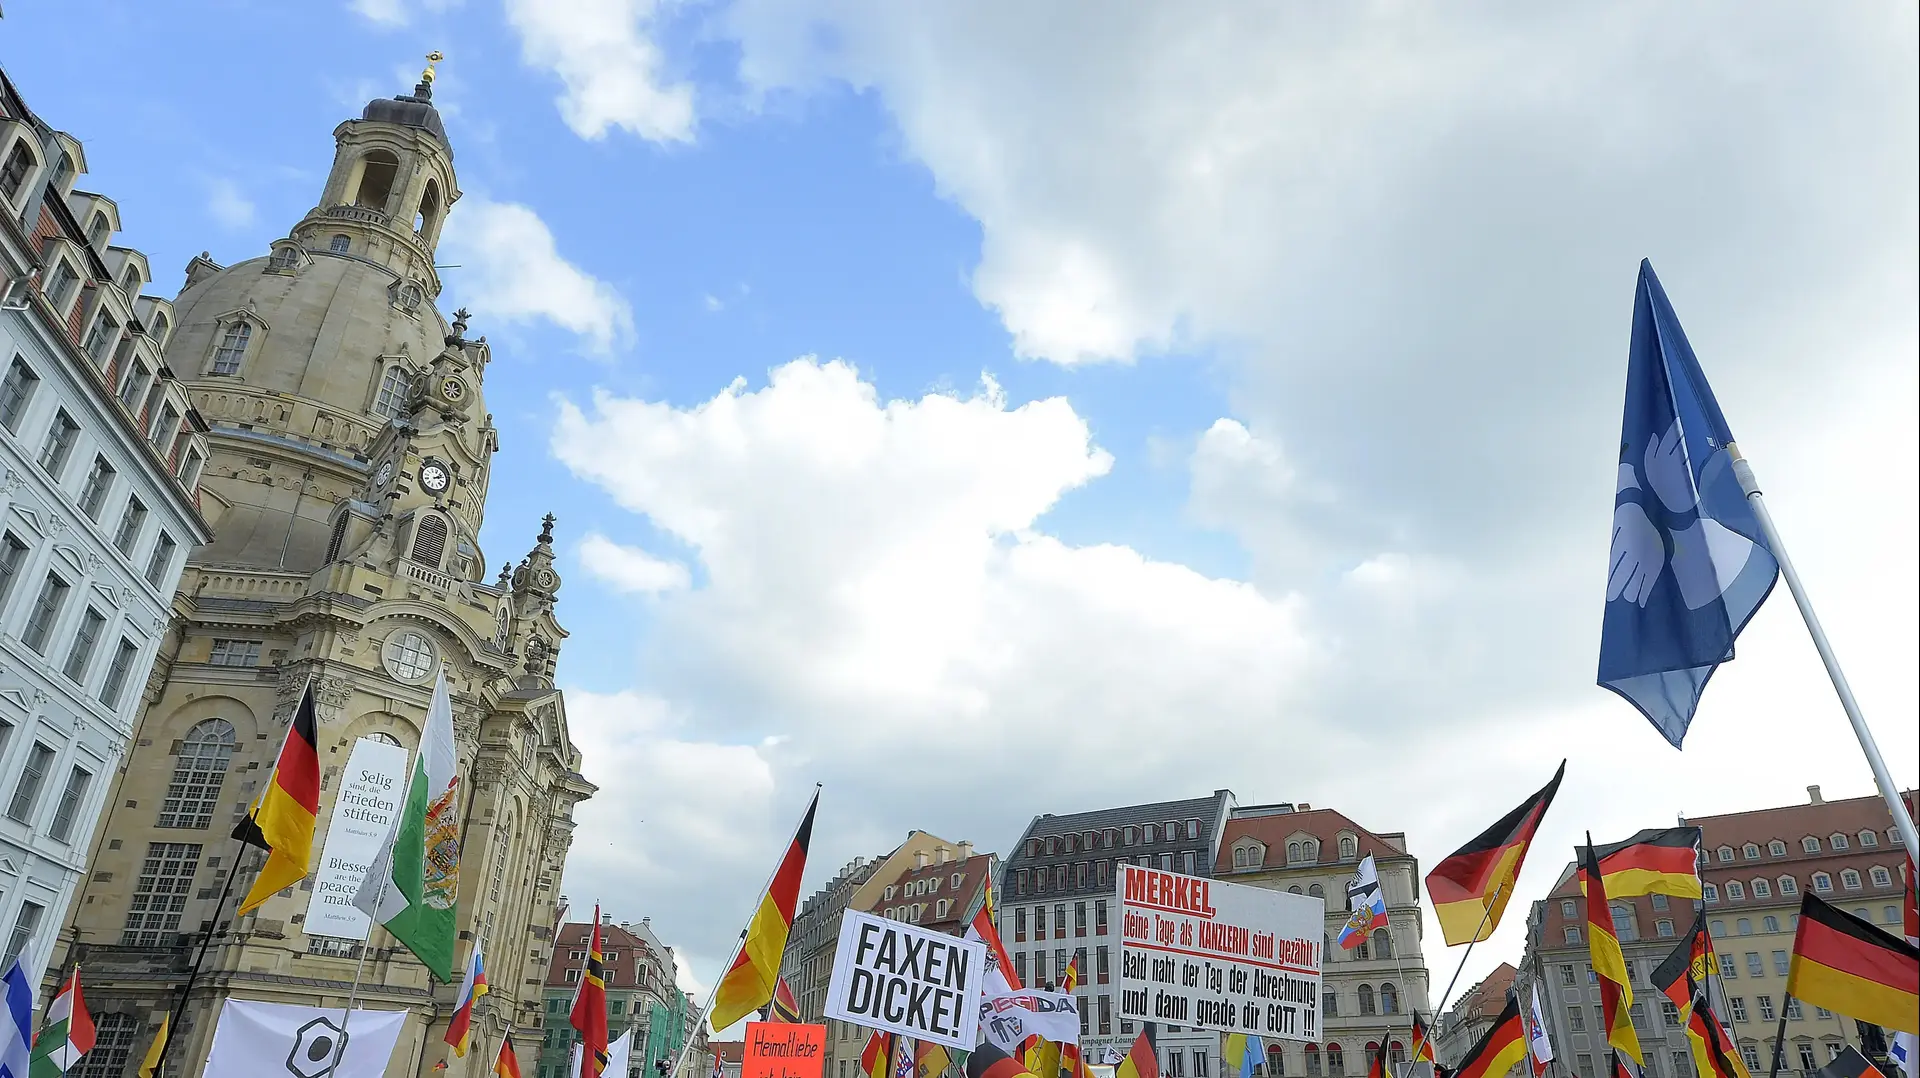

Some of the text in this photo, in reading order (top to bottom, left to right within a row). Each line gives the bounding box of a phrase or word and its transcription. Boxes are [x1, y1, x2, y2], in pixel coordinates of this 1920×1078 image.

[349, 782, 381, 794] sind, die
[360, 770, 393, 790] Selig
[342, 790, 394, 811] Frieden
[319, 881, 358, 894] peace-
[349, 875, 362, 883] the
[1124, 867, 1216, 917] MERKEL,
[1124, 910, 1149, 940] deine
[1155, 914, 1175, 946] Tage
[1180, 919, 1193, 947] als
[1199, 920, 1249, 955] KANZLERIN
[1252, 930, 1273, 960] sind
[1279, 938, 1313, 967] gezählt
[856, 922, 969, 992] FAXEN
[1123, 950, 1316, 1008] Bald naht der Tag der Abrechnung
[847, 968, 963, 1038] DICKE!
[979, 996, 1077, 1021] PEGIDA
[1123, 987, 1315, 1037] und dann gnade dir GOTT !!!
[753, 1029, 818, 1058] Heimatliebe
[1081, 1037, 1113, 1046] ampagner
